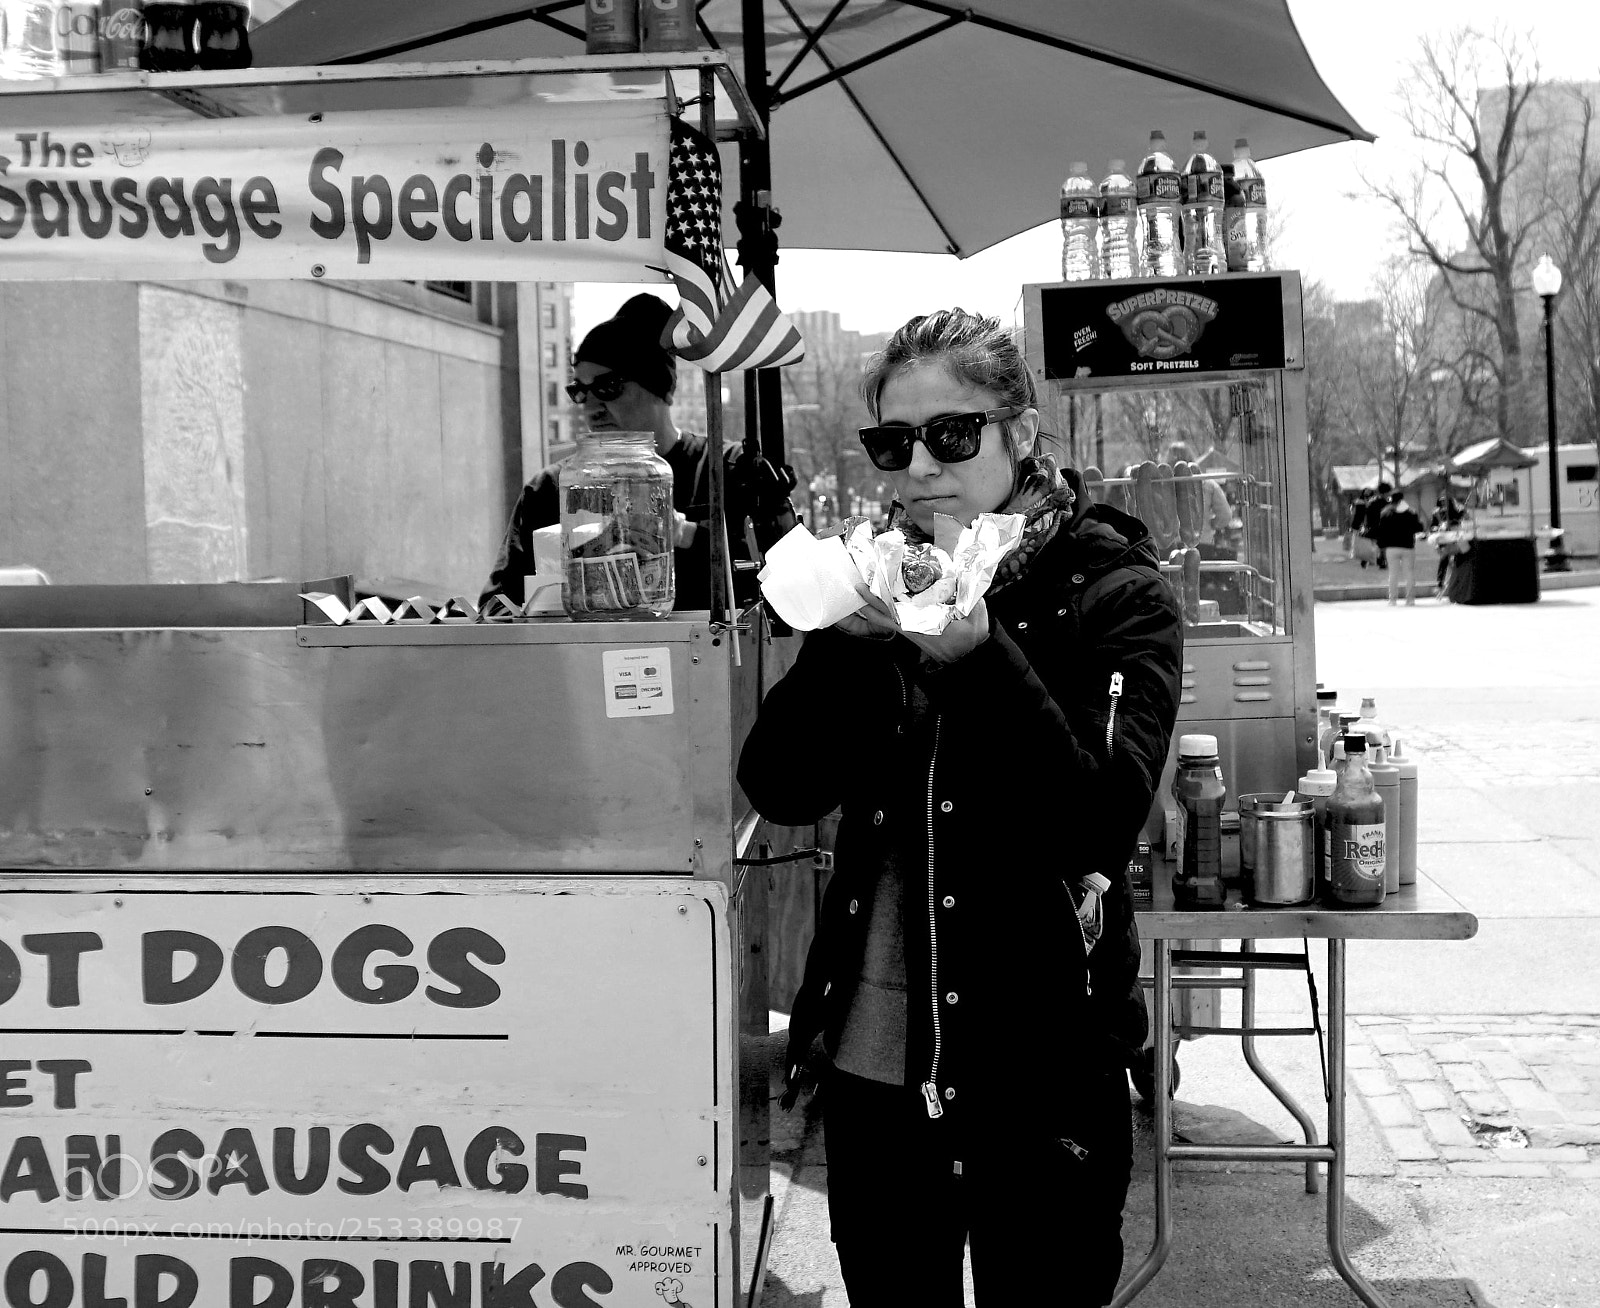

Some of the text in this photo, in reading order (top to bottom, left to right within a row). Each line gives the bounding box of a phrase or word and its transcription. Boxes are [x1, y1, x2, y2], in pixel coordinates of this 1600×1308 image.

[15, 131, 95, 168] The
[308, 139, 655, 264] Specialist
[1107, 289, 1217, 320] SUPERPRETZEL
[1074, 325, 1092, 339] OVEN
[1074, 331, 1097, 347] FRESH!
[1130, 360, 1199, 371] SOFT PRETZELS
[142, 923, 506, 1010] DOGS
[149, 1123, 589, 1201] SAUSAGE
[615, 1245, 702, 1258] MR. GOURMET
[229, 1256, 614, 1308] DRINKS
[629, 1261, 692, 1274] APPROVED
